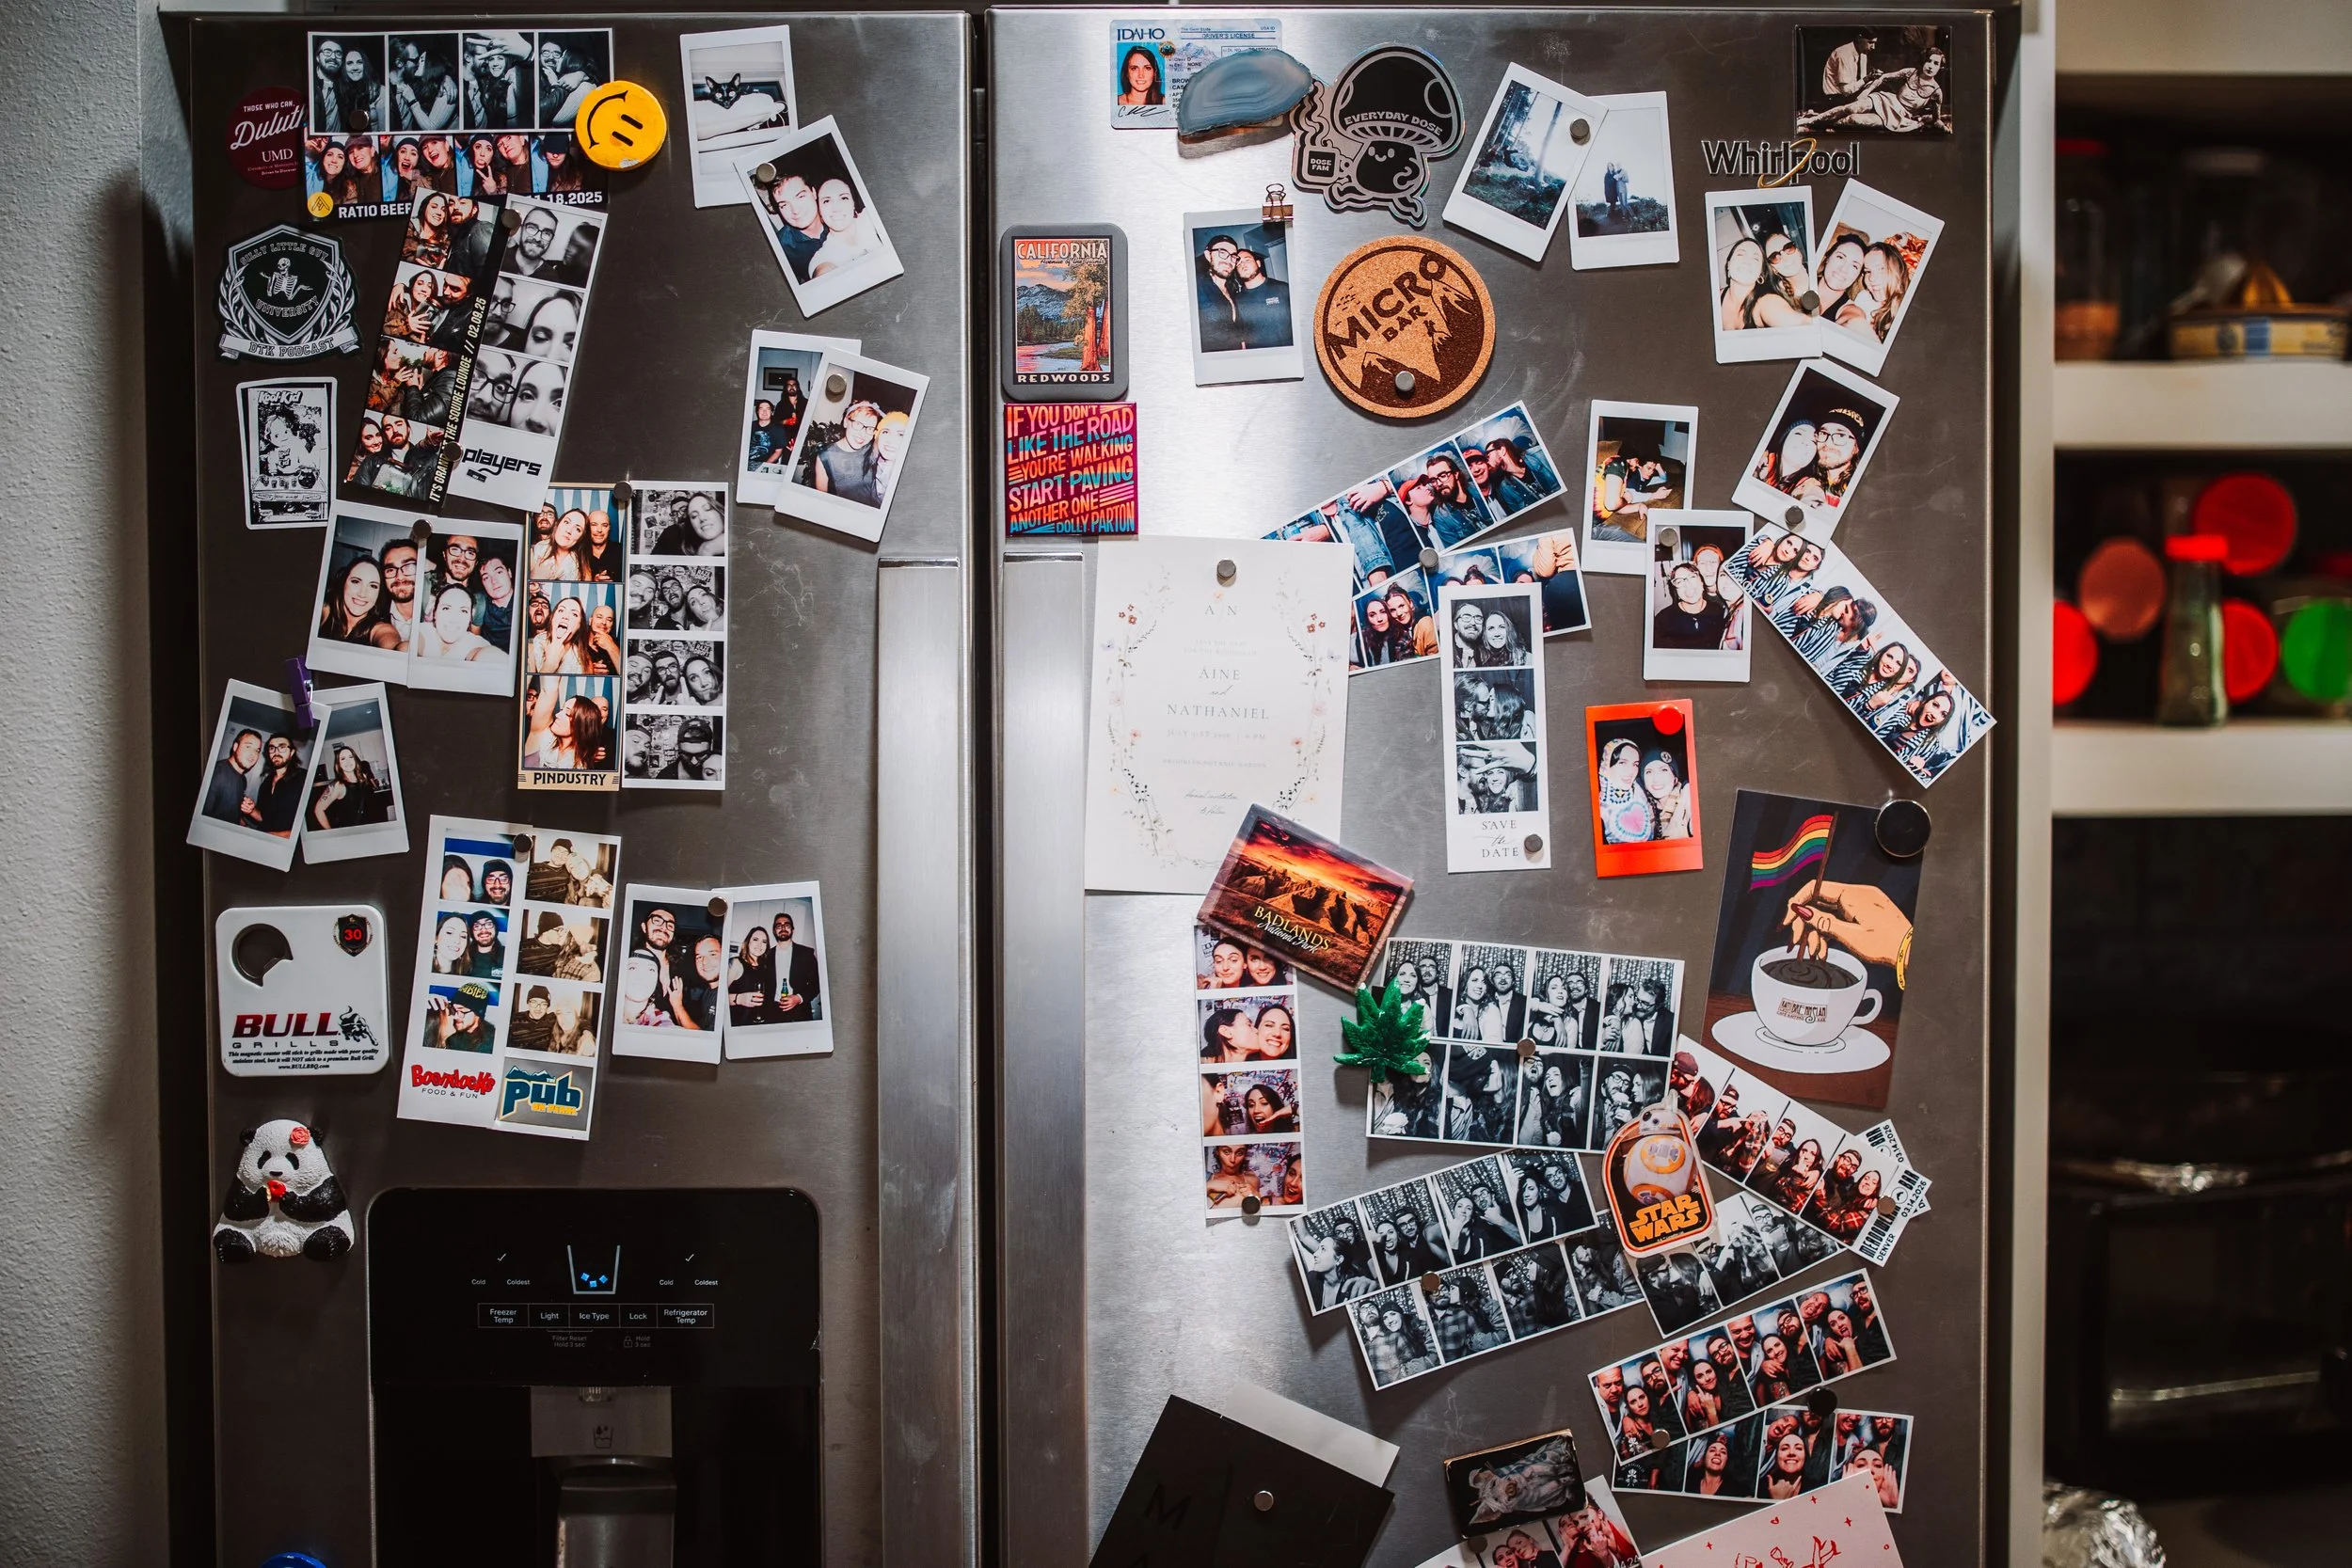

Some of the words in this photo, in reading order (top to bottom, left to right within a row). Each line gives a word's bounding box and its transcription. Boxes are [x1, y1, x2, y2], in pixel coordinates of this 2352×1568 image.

[1117, 28, 1165, 40] IDAHO
[244, 103, 262, 112] THOSE
[1343, 111, 1409, 125] EVERYDAY
[1411, 116, 1443, 136] DOSE
[262, 149, 294, 162] UMD
[1701, 140, 1860, 185] Whirlpool
[339, 204, 377, 218] RATIO
[240, 245, 267, 264] SILLY
[270, 242, 307, 252] LITTLE
[309, 245, 329, 261] GUY
[1017, 242, 1107, 260] CALIFORNIA
[255, 295, 320, 318] UNIVERSITY
[466, 296, 486, 338] 02.09.25
[1327, 253, 1447, 360] MICRO
[1381, 305, 1428, 342] BAR
[248, 342, 275, 356] DTK
[279, 338, 335, 356] PODCAST
[454, 355, 472, 390] LOUNGE
[1018, 373, 1110, 383] REDWOODS
[448, 389, 465, 421] SQUIRE
[444, 422, 457, 440] THE
[1008, 406, 1025, 438] IF
[1025, 405, 1060, 433] YOU
[1063, 404, 1098, 423] DON'T
[1008, 430, 1047, 465] LIKE
[1050, 420, 1085, 452] THE
[1087, 407, 1135, 442] ROAD
[462, 447, 542, 476] players
[1020, 452, 1067, 481] YOU'RE
[1070, 434, 1134, 467] WALKING
[428, 483, 443, 501] IT'S
[1009, 473, 1065, 513] START
[1069, 455, 1134, 496] PAVING
[1009, 499, 1069, 533] ANOTHER
[1072, 490, 1099, 515] ONE
[1056, 514, 1089, 533] DOLLY
[1091, 501, 1136, 533] PARTON
[1167, 704, 1269, 720] NATHANIEL
[533, 771, 608, 787] PINDUSTRY
[1482, 820, 1517, 830] SAVE
[1482, 847, 1518, 858] DATE
[344, 928, 362, 941] 30
[1254, 905, 1331, 950] BADLANDS
[1256, 919, 1295, 945] National
[1294, 937, 1318, 954] Park
[232, 1012, 340, 1038] BULL
[232, 1039, 339, 1049] GRILLS
[421, 1088, 446, 1097] FOOD
[1883, 1124, 1904, 1163] 03.14.2026
[1629, 1194, 1699, 1228] STAR
[1900, 1180, 1928, 1218] 03.14.2026
[1630, 1206, 1701, 1243] WARS
[1876, 1233, 1896, 1261] DENVER
[494, 1316, 514, 1324] Temp
[540, 1312, 559, 1321] Light
[592, 1312, 610, 1322] Type
[663, 1308, 707, 1317] Refrigerator
